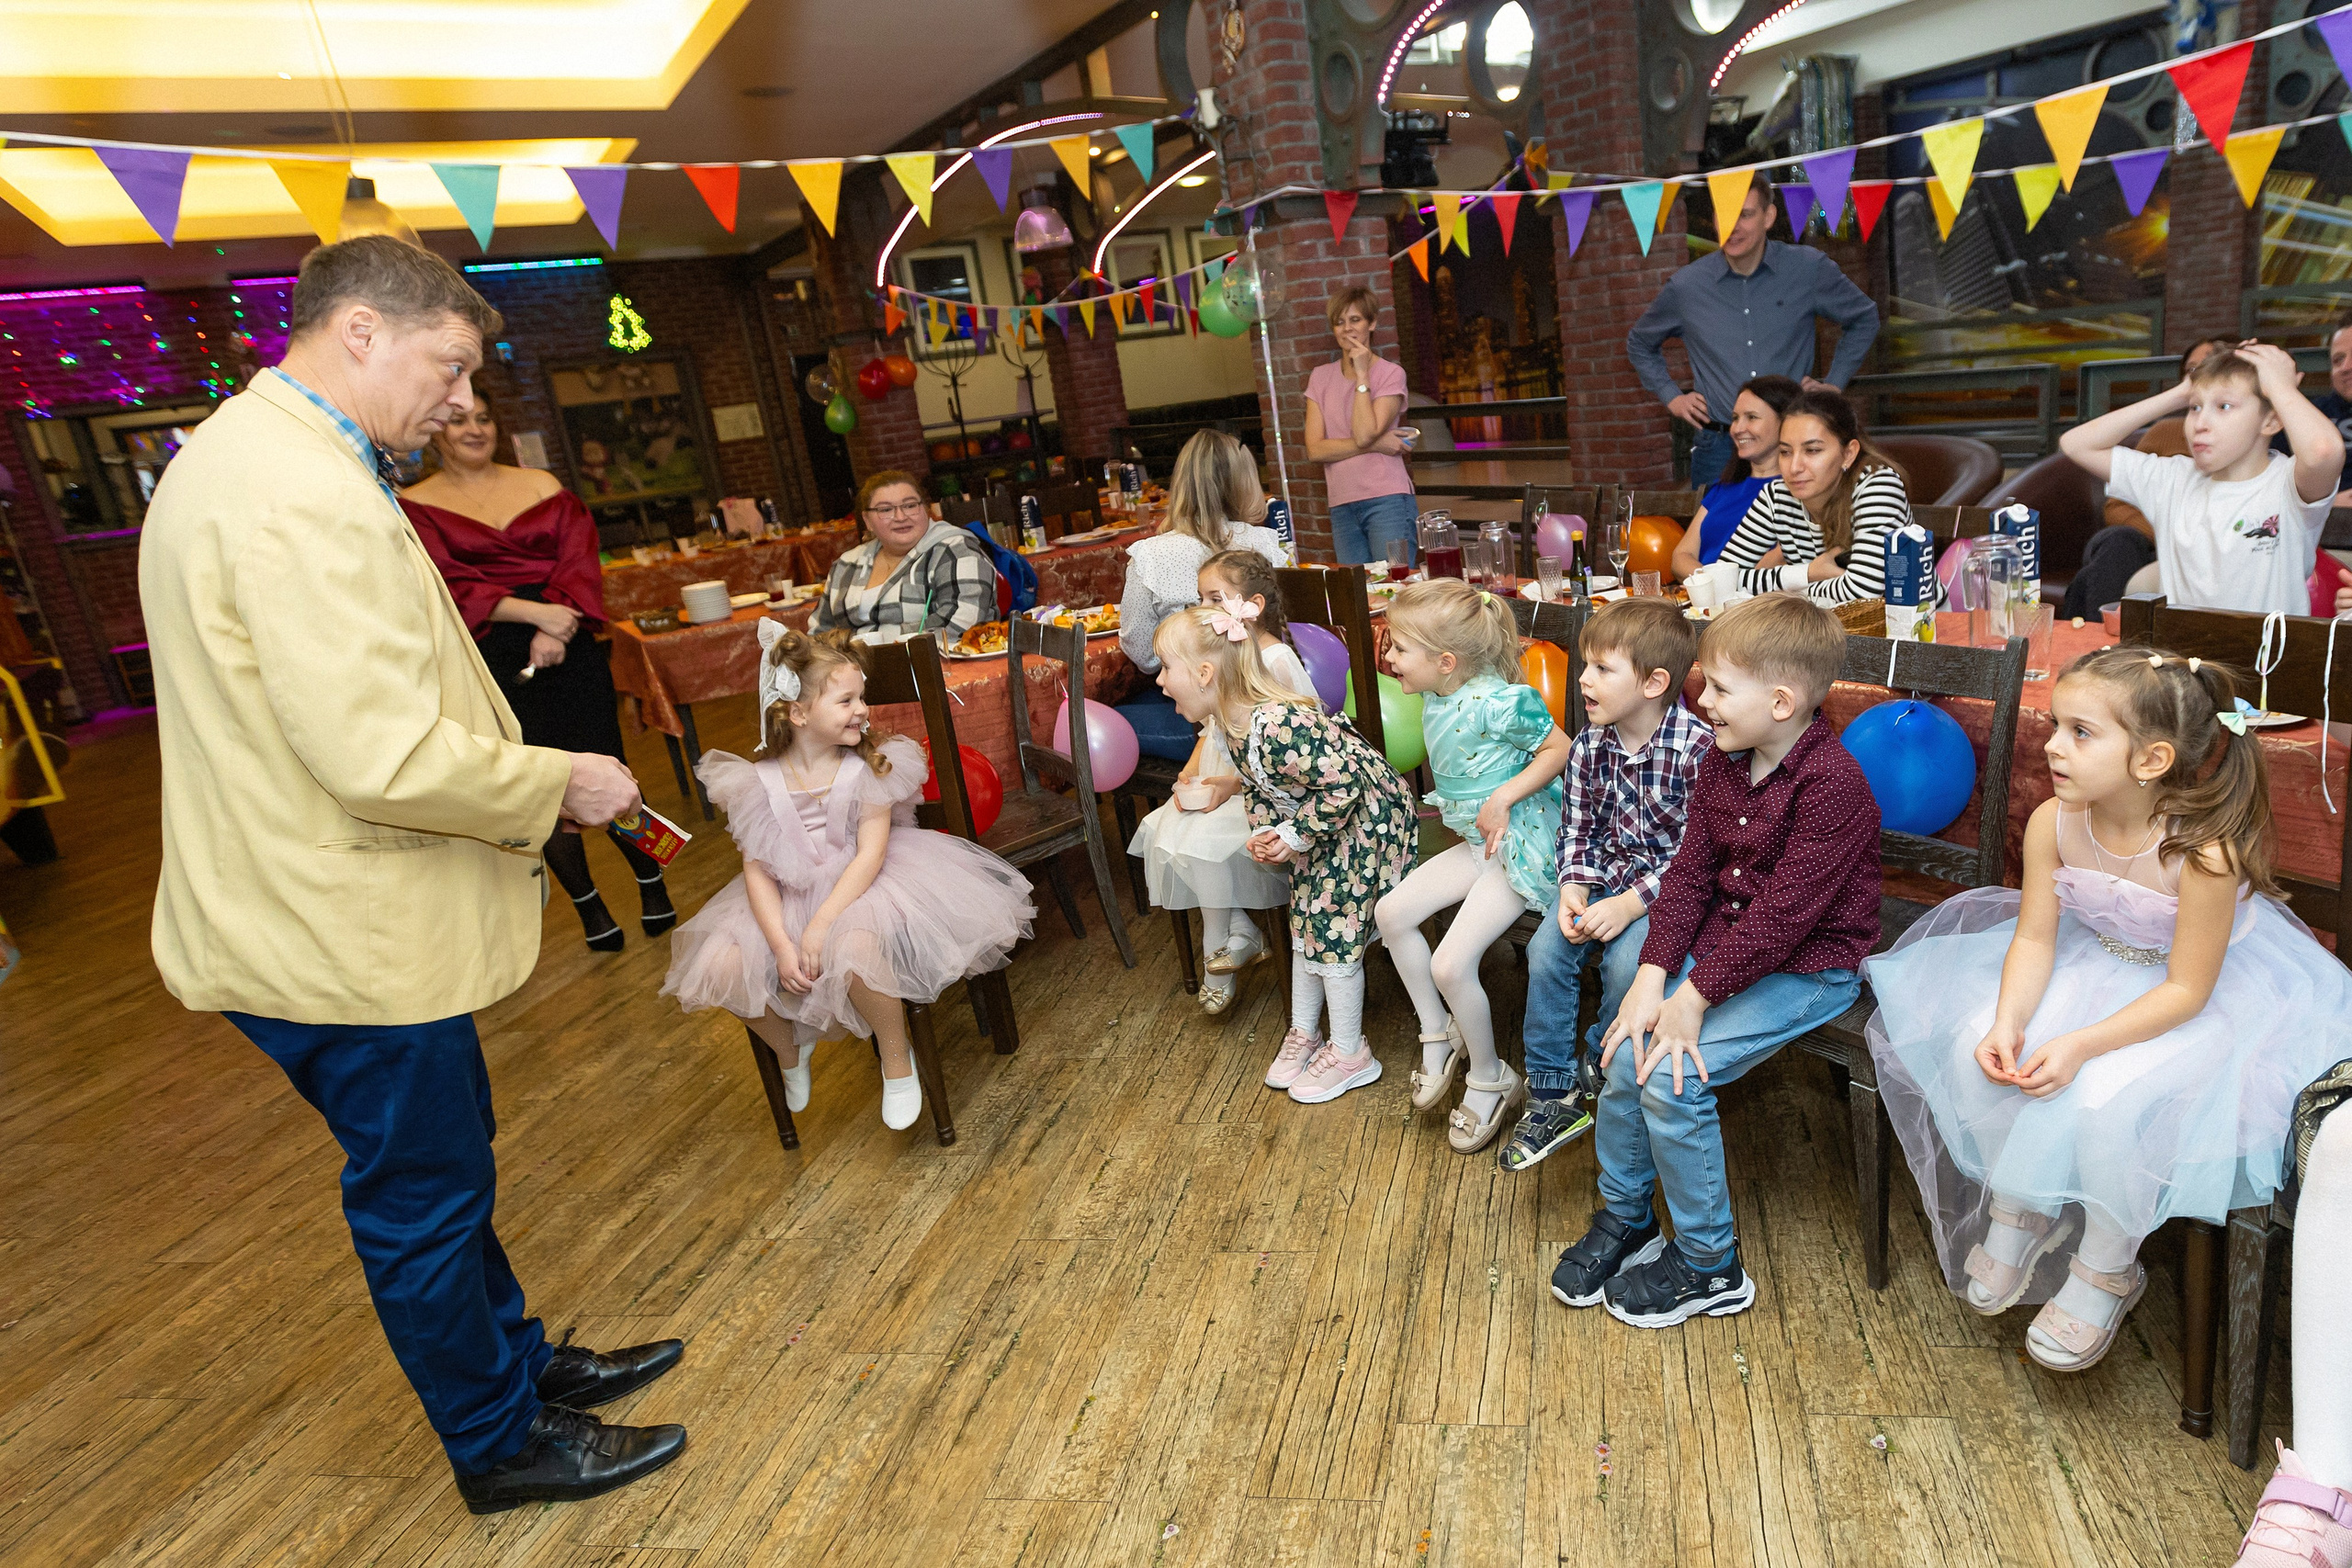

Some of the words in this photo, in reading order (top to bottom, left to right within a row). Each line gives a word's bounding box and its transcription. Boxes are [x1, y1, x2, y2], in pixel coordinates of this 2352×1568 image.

[1021, 504, 1031, 528] Rich
[1274, 510, 1289, 541] Rich
[1919, 546, 1933, 602] Rich
